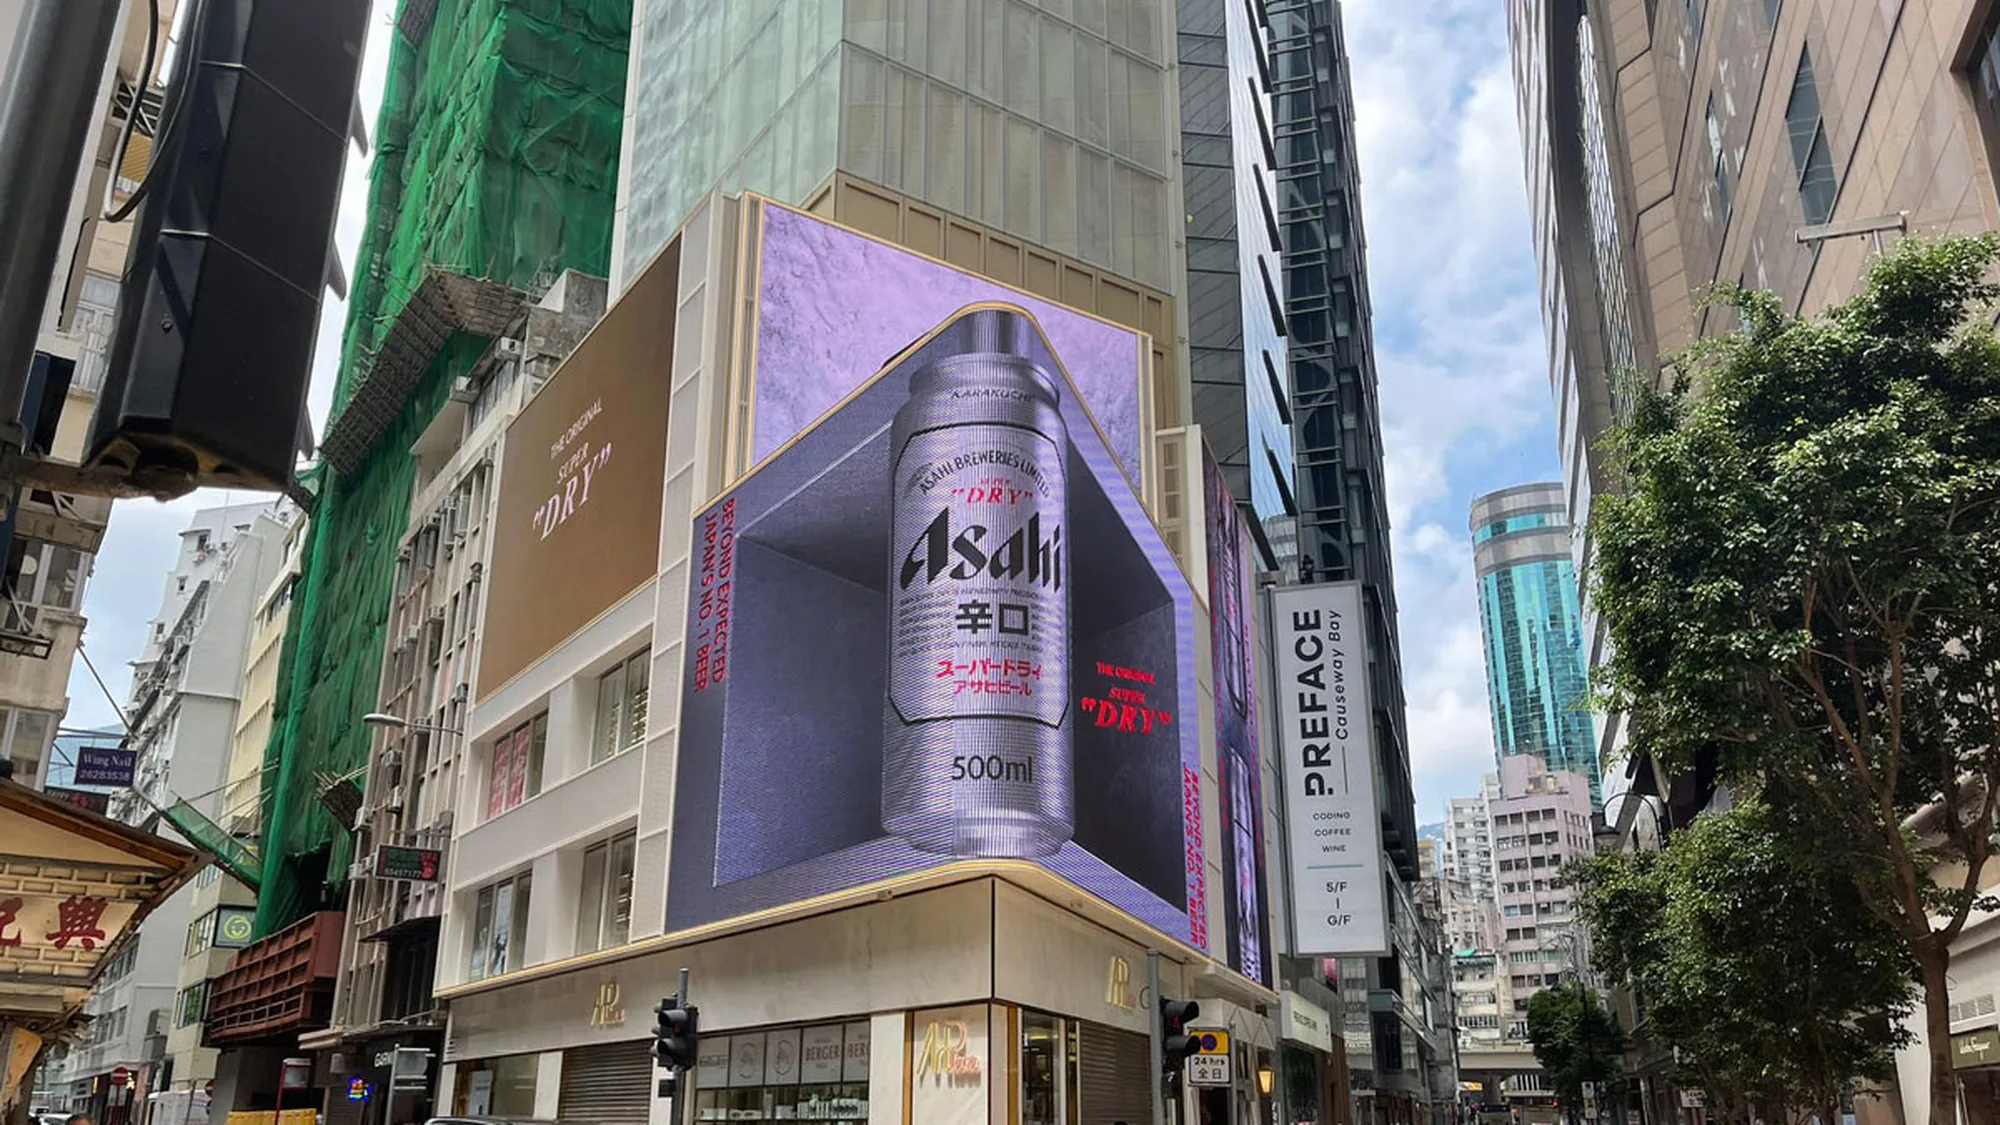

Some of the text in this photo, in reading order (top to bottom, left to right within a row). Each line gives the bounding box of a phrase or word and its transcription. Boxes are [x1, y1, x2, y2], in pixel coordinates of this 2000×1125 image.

[920, 463, 955, 495] ASAHI
[954, 450, 1020, 471] BREWERIES
[701, 513, 719, 588] JAPAN'S
[900, 506, 1061, 593] Asahi
[712, 497, 738, 684] BEYOND EXPECTED
[699, 588, 714, 627] NO.
[956, 599, 1029, 636] 辛口
[694, 644, 712, 693] BEER
[935, 658, 1041, 680] スーパードライ
[1329, 610, 1349, 740] Causeway Bay
[953, 680, 1032, 697] アサヒビール
[951, 755, 1033, 784] 500ml
[1313, 811, 1351, 820] CODING
[1314, 828, 1351, 837] COFFEE
[1322, 845, 1347, 853] WINE
[1327, 914, 1351, 927] G/F
[805, 1045, 840, 1061] BERGER
[1194, 1057, 1225, 1065] 24 hrs
[1198, 1068, 1221, 1079] 全日
